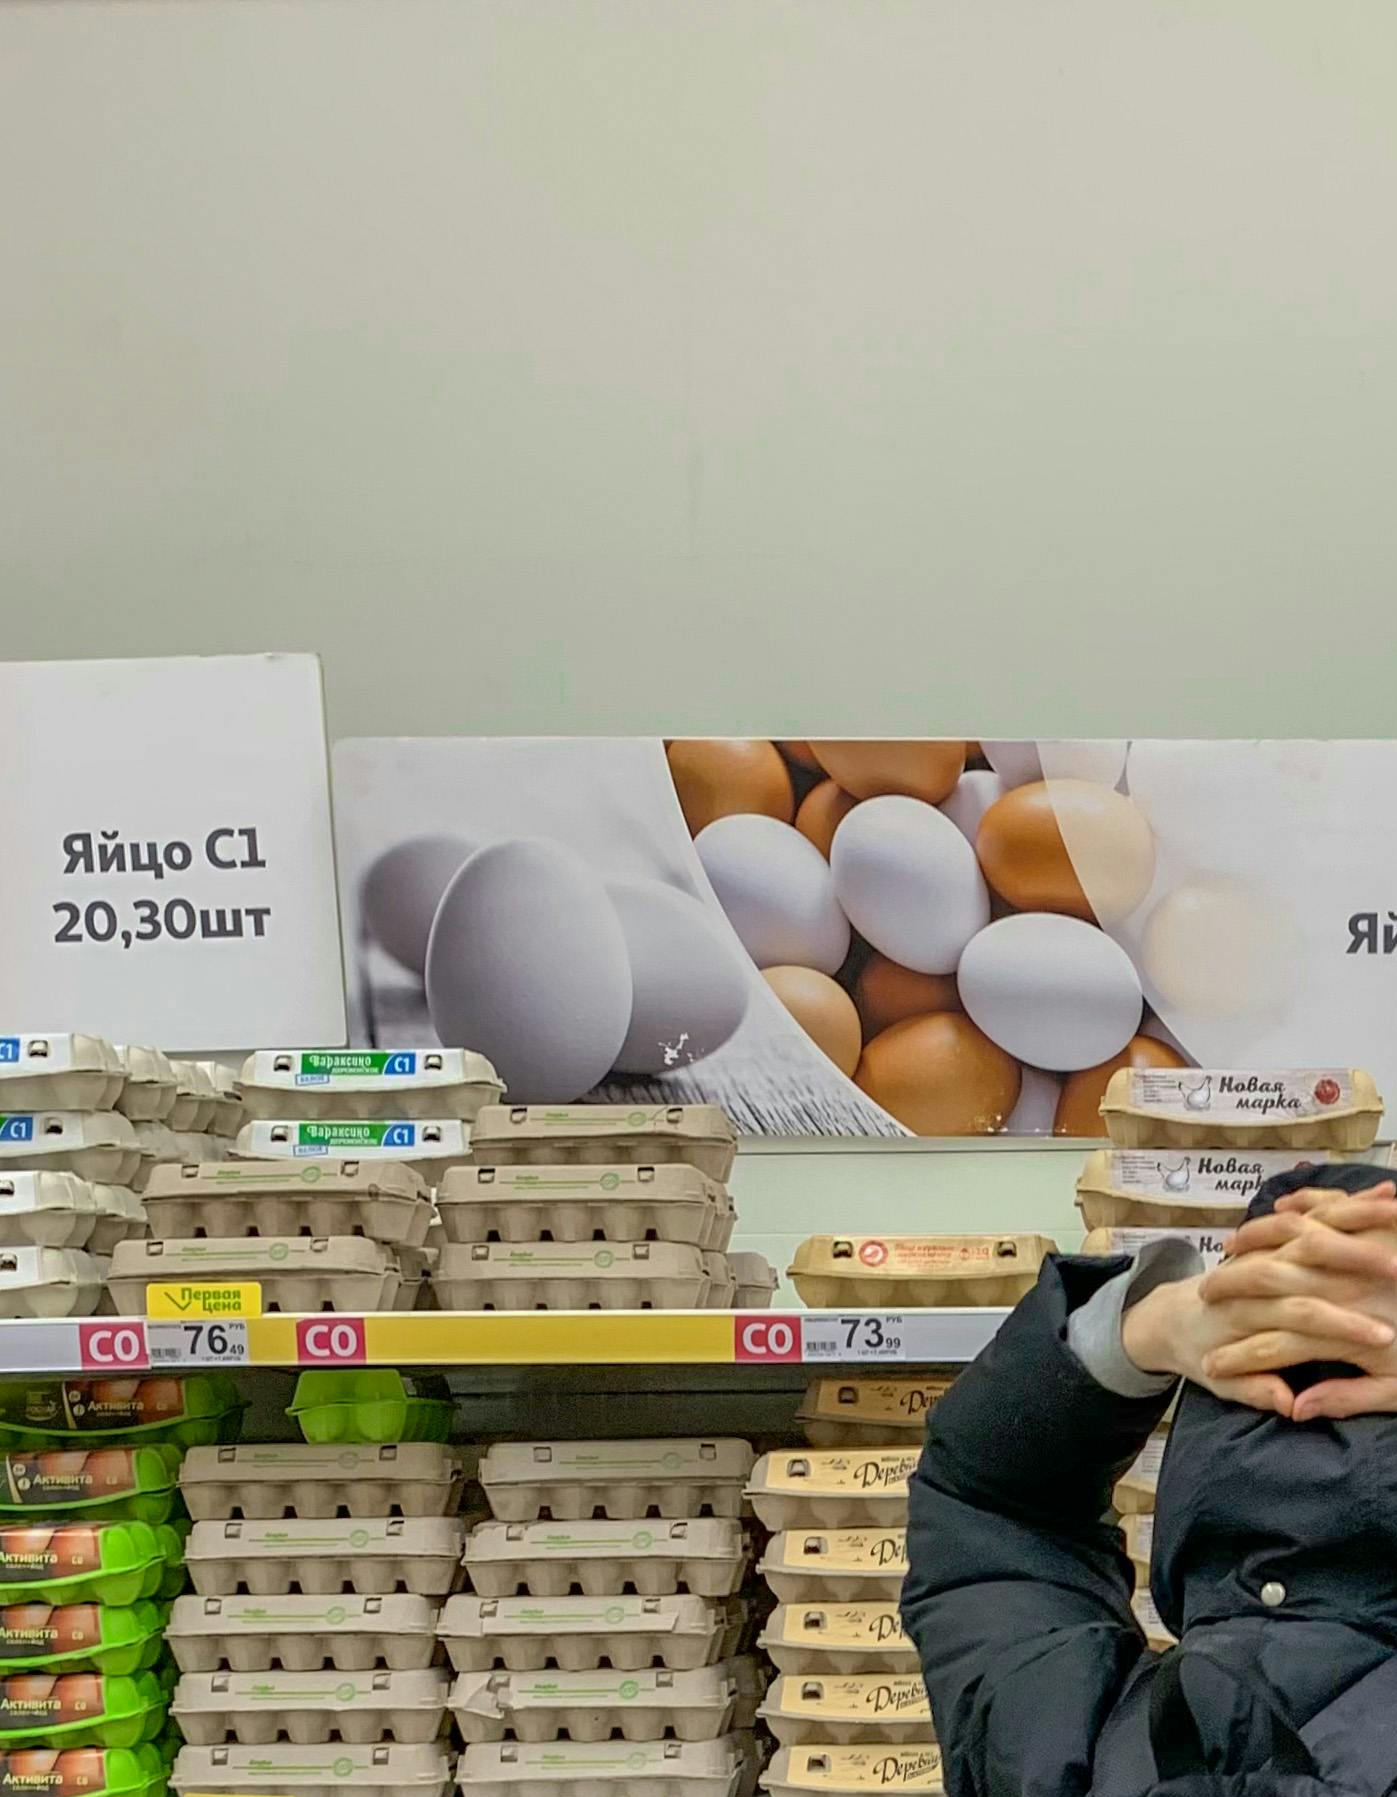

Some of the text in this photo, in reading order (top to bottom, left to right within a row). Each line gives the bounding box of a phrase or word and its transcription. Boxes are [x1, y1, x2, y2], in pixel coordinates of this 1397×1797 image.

[62, 831, 192, 879] Яйцо
[52, 900, 271, 948] 20,30шт
[1219, 1076, 1285, 1093] Новая
[1236, 1093, 1301, 1114] марка
[1198, 1158, 1264, 1174] Новая
[1215, 1175, 1265, 1196] марк
[181, 1288, 241, 1301] Первая
[184, 1325, 244, 1355] 76 49
[841, 1318, 900, 1349] 73 99
[1, 1699, 61, 1710] Активита
[3, 1774, 63, 1785] Активита
